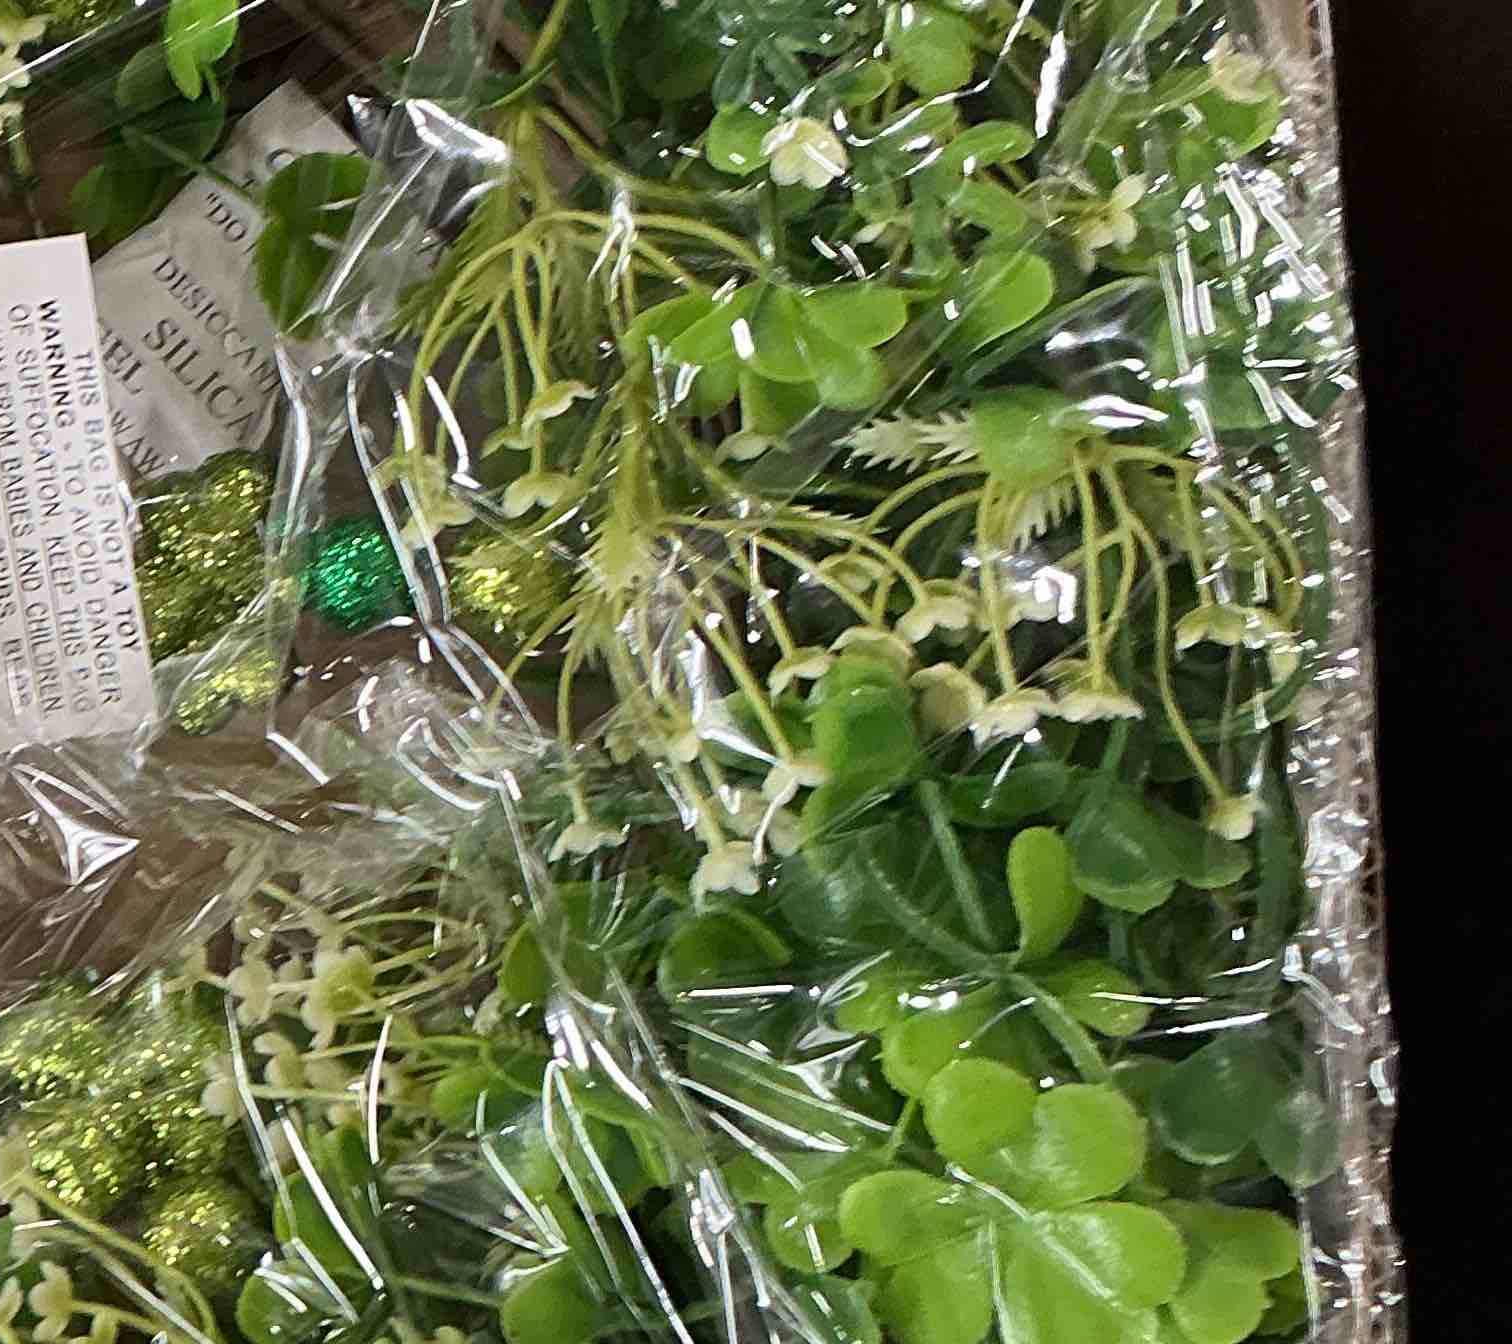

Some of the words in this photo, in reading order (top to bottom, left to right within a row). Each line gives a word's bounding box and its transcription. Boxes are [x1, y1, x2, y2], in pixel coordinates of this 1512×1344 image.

[8, 304, 33, 337] OF
[38, 299, 76, 427] WARNING
[74, 353, 99, 406] THIS
[143, 319, 255, 441] SILICA
[84, 419, 109, 472] BAG
[0, 457, 33, 536] BABIES
[63, 460, 87, 495] TO
[94, 484, 113, 505] IS
[47, 535, 75, 595] KEEP
[71, 504, 101, 584] AVOID
[101, 519, 124, 568] NOT
[16, 548, 42, 591] AND
[111, 578, 128, 593] A
[58, 606, 86, 656] THIS
[86, 598, 121, 704] DANGER
[116, 607, 139, 652] TOY
[69, 667, 94, 712] BAG
